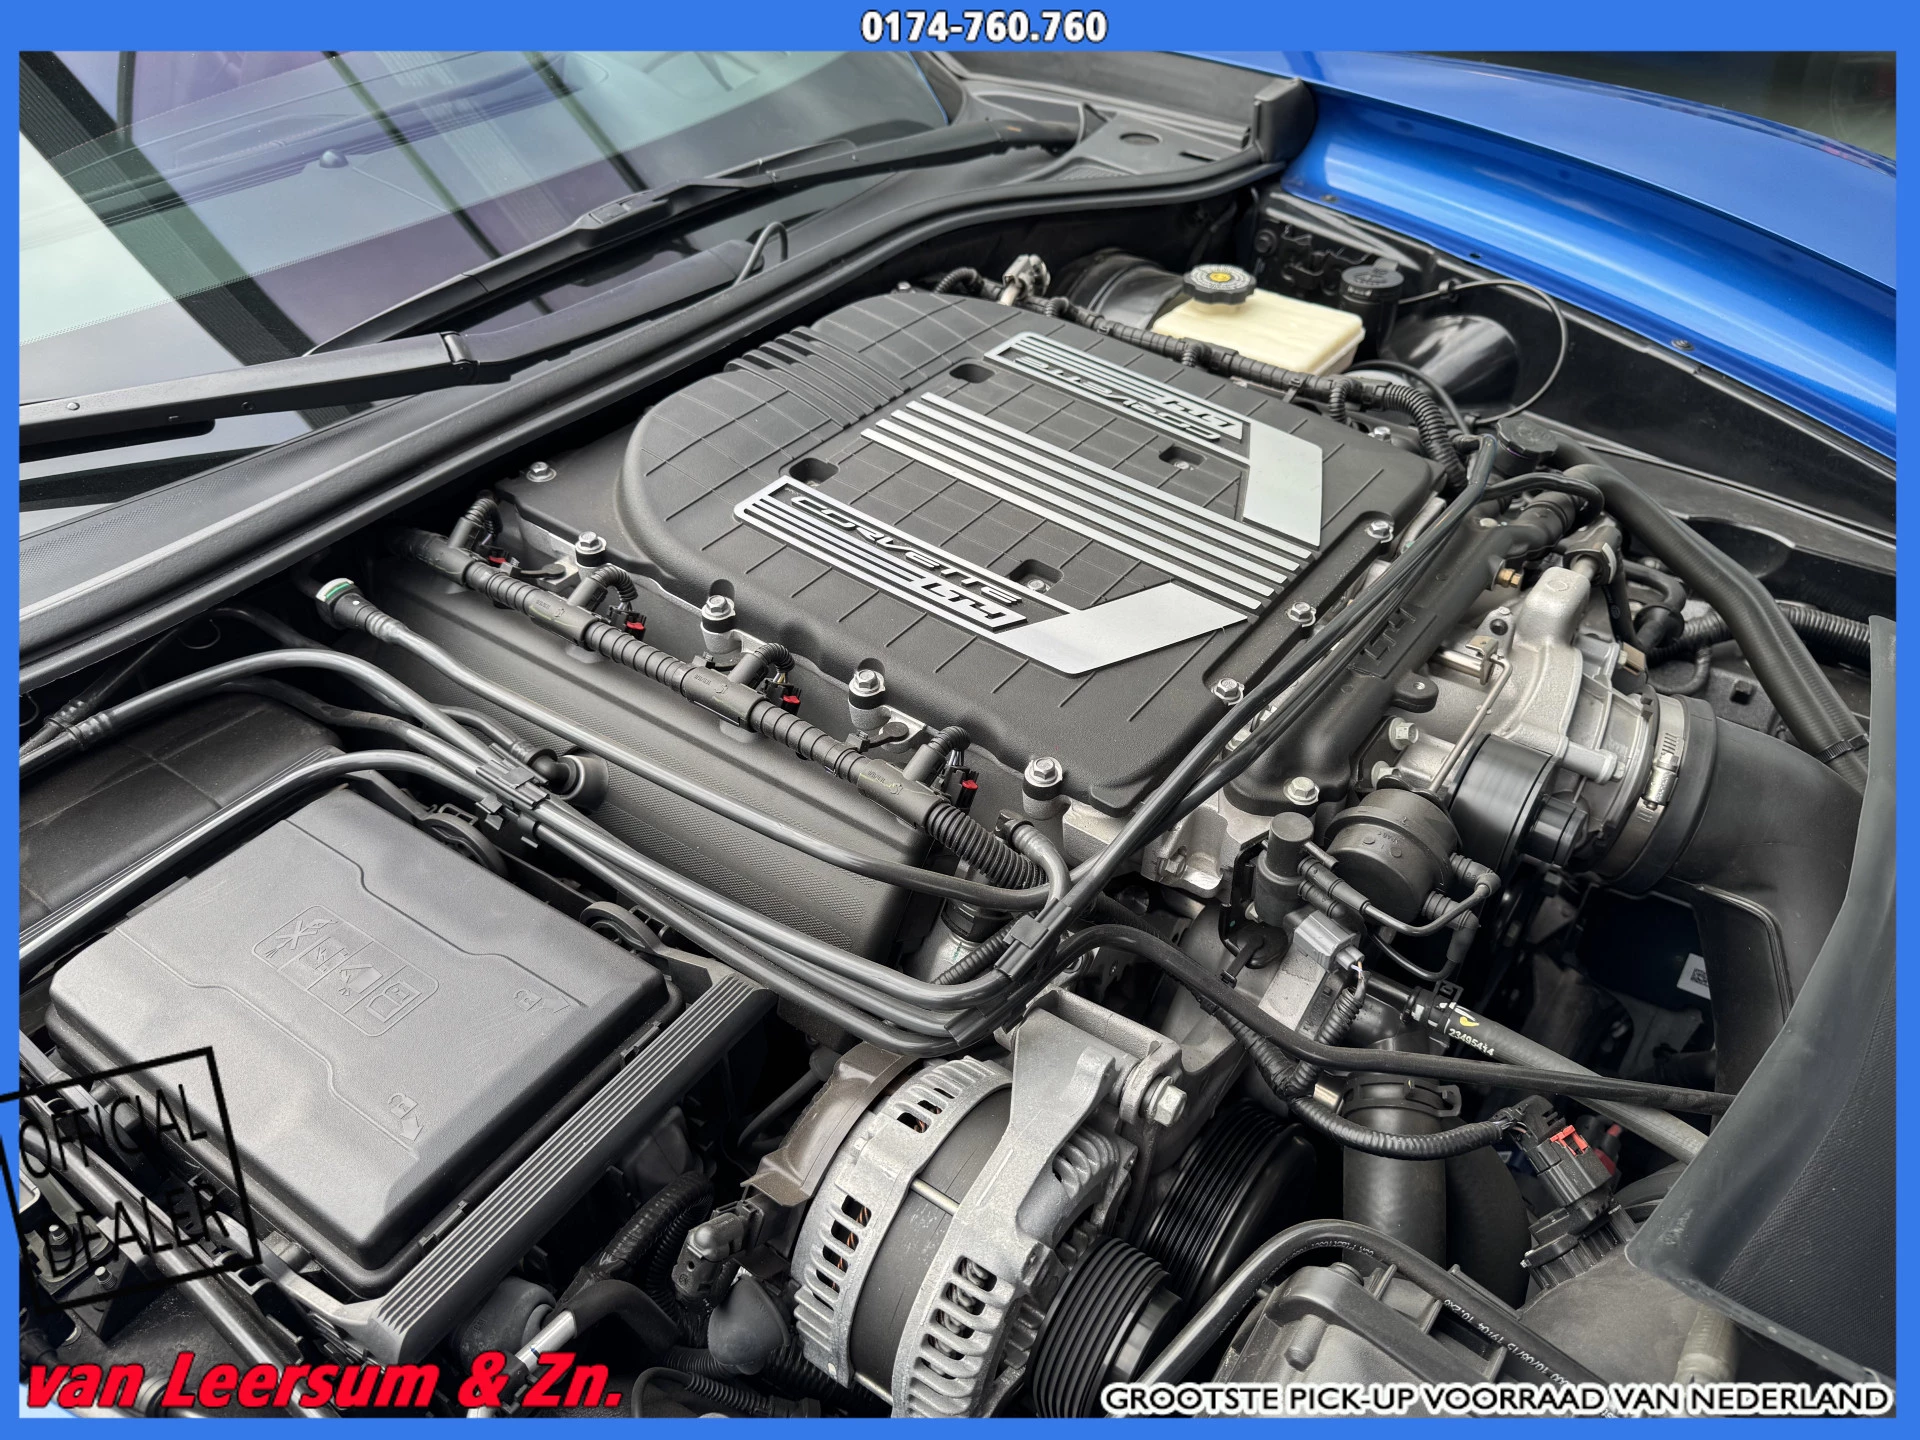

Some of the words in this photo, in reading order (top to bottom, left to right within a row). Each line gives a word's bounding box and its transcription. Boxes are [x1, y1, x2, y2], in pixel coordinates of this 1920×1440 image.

[1013, 355, 1221, 443] CORVETTE
[790, 496, 1023, 606] CORVETTE
[920, 582, 1007, 621] LT4
